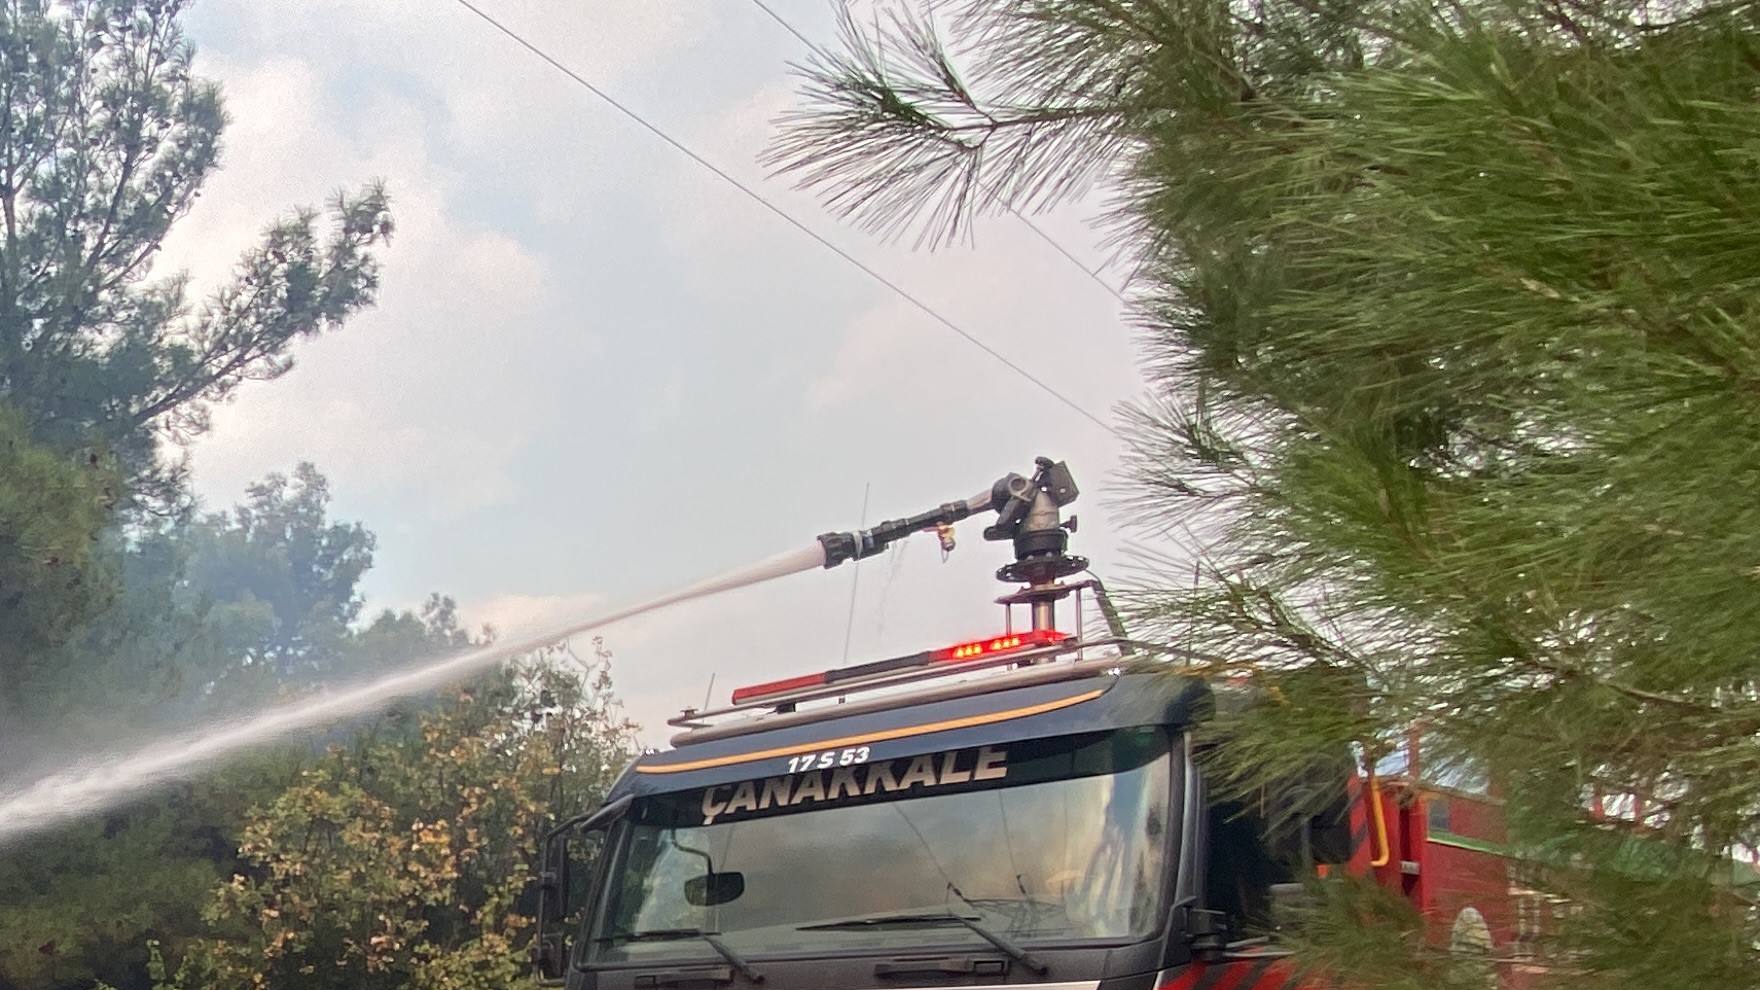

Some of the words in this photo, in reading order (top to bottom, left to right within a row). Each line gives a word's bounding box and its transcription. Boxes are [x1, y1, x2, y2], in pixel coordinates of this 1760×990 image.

[788, 753, 814, 773] 17
[817, 753, 835, 769] S
[840, 747, 870, 764] 53
[701, 749, 1007, 825] ÇANAKKALE
